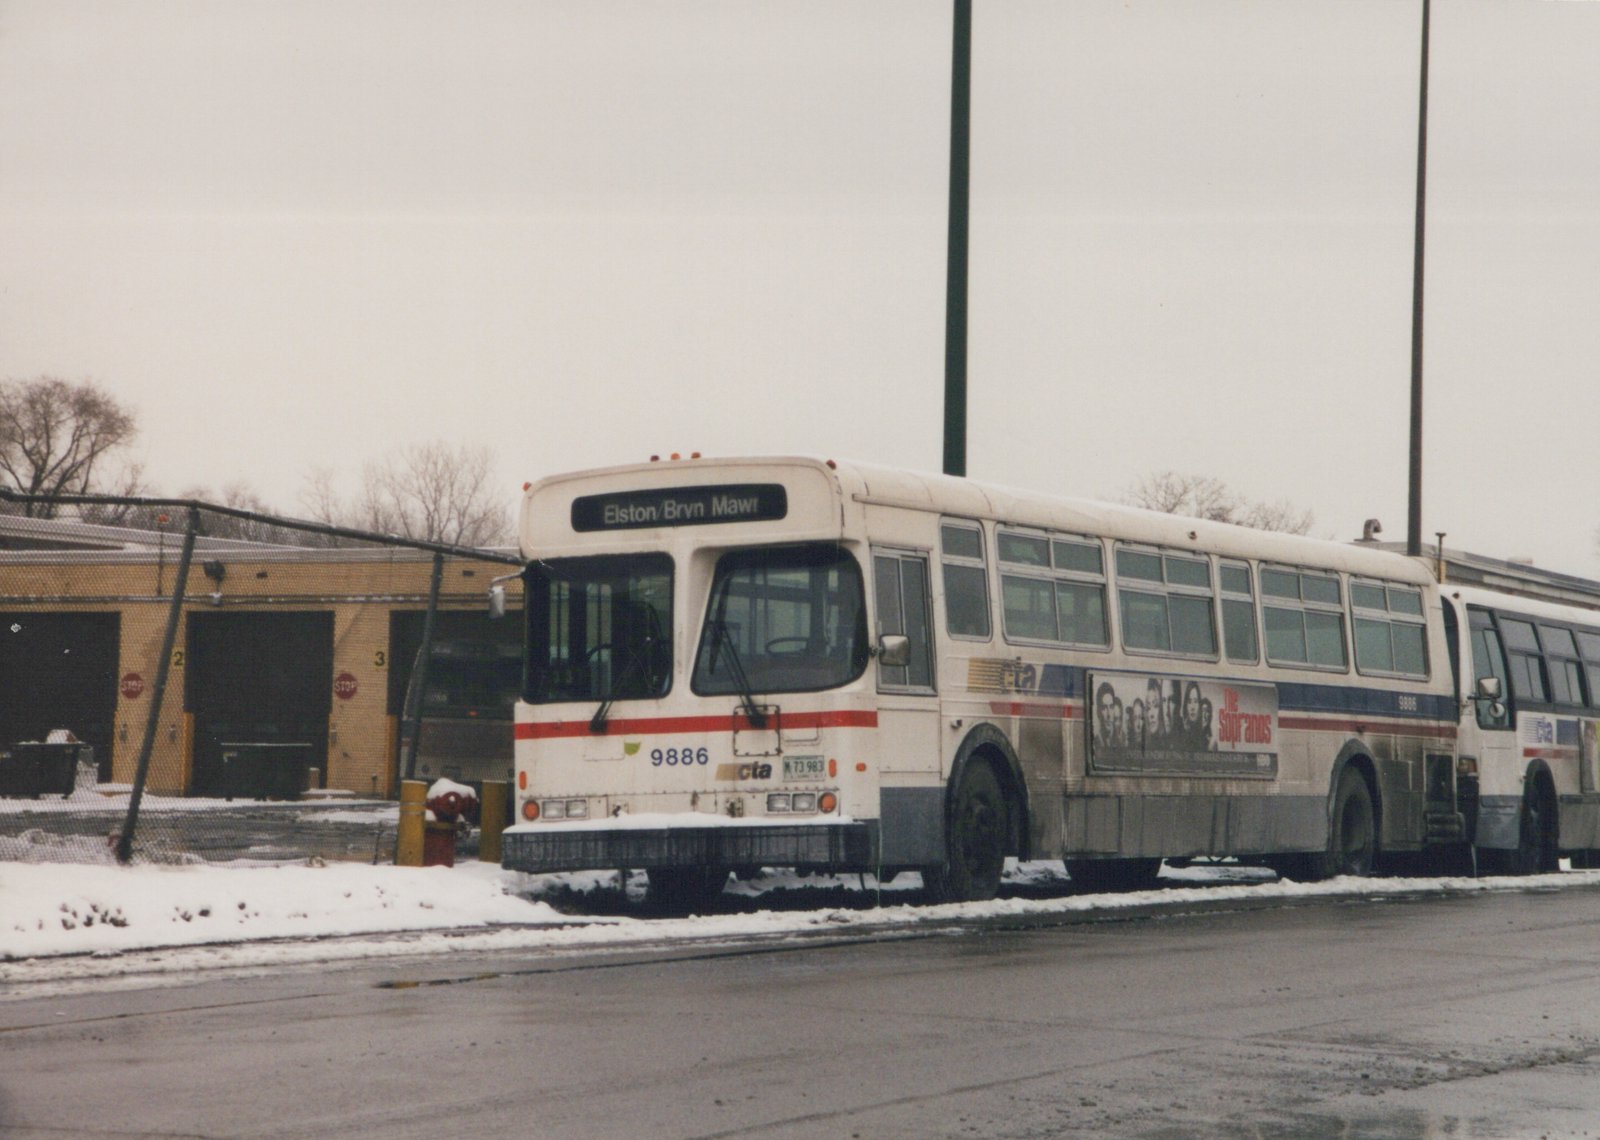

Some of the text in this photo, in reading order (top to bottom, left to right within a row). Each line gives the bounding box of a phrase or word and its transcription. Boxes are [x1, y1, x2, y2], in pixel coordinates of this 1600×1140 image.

[712, 495, 759, 517] Mawr
[174, 651, 184, 666] 2
[374, 651, 385, 667] 3
[121, 680, 144, 691] STOP
[335, 680, 357, 692] STOP
[1218, 708, 1272, 749] Sopranos
[651, 747, 709, 767] 9886
[738, 761, 772, 780] cta
